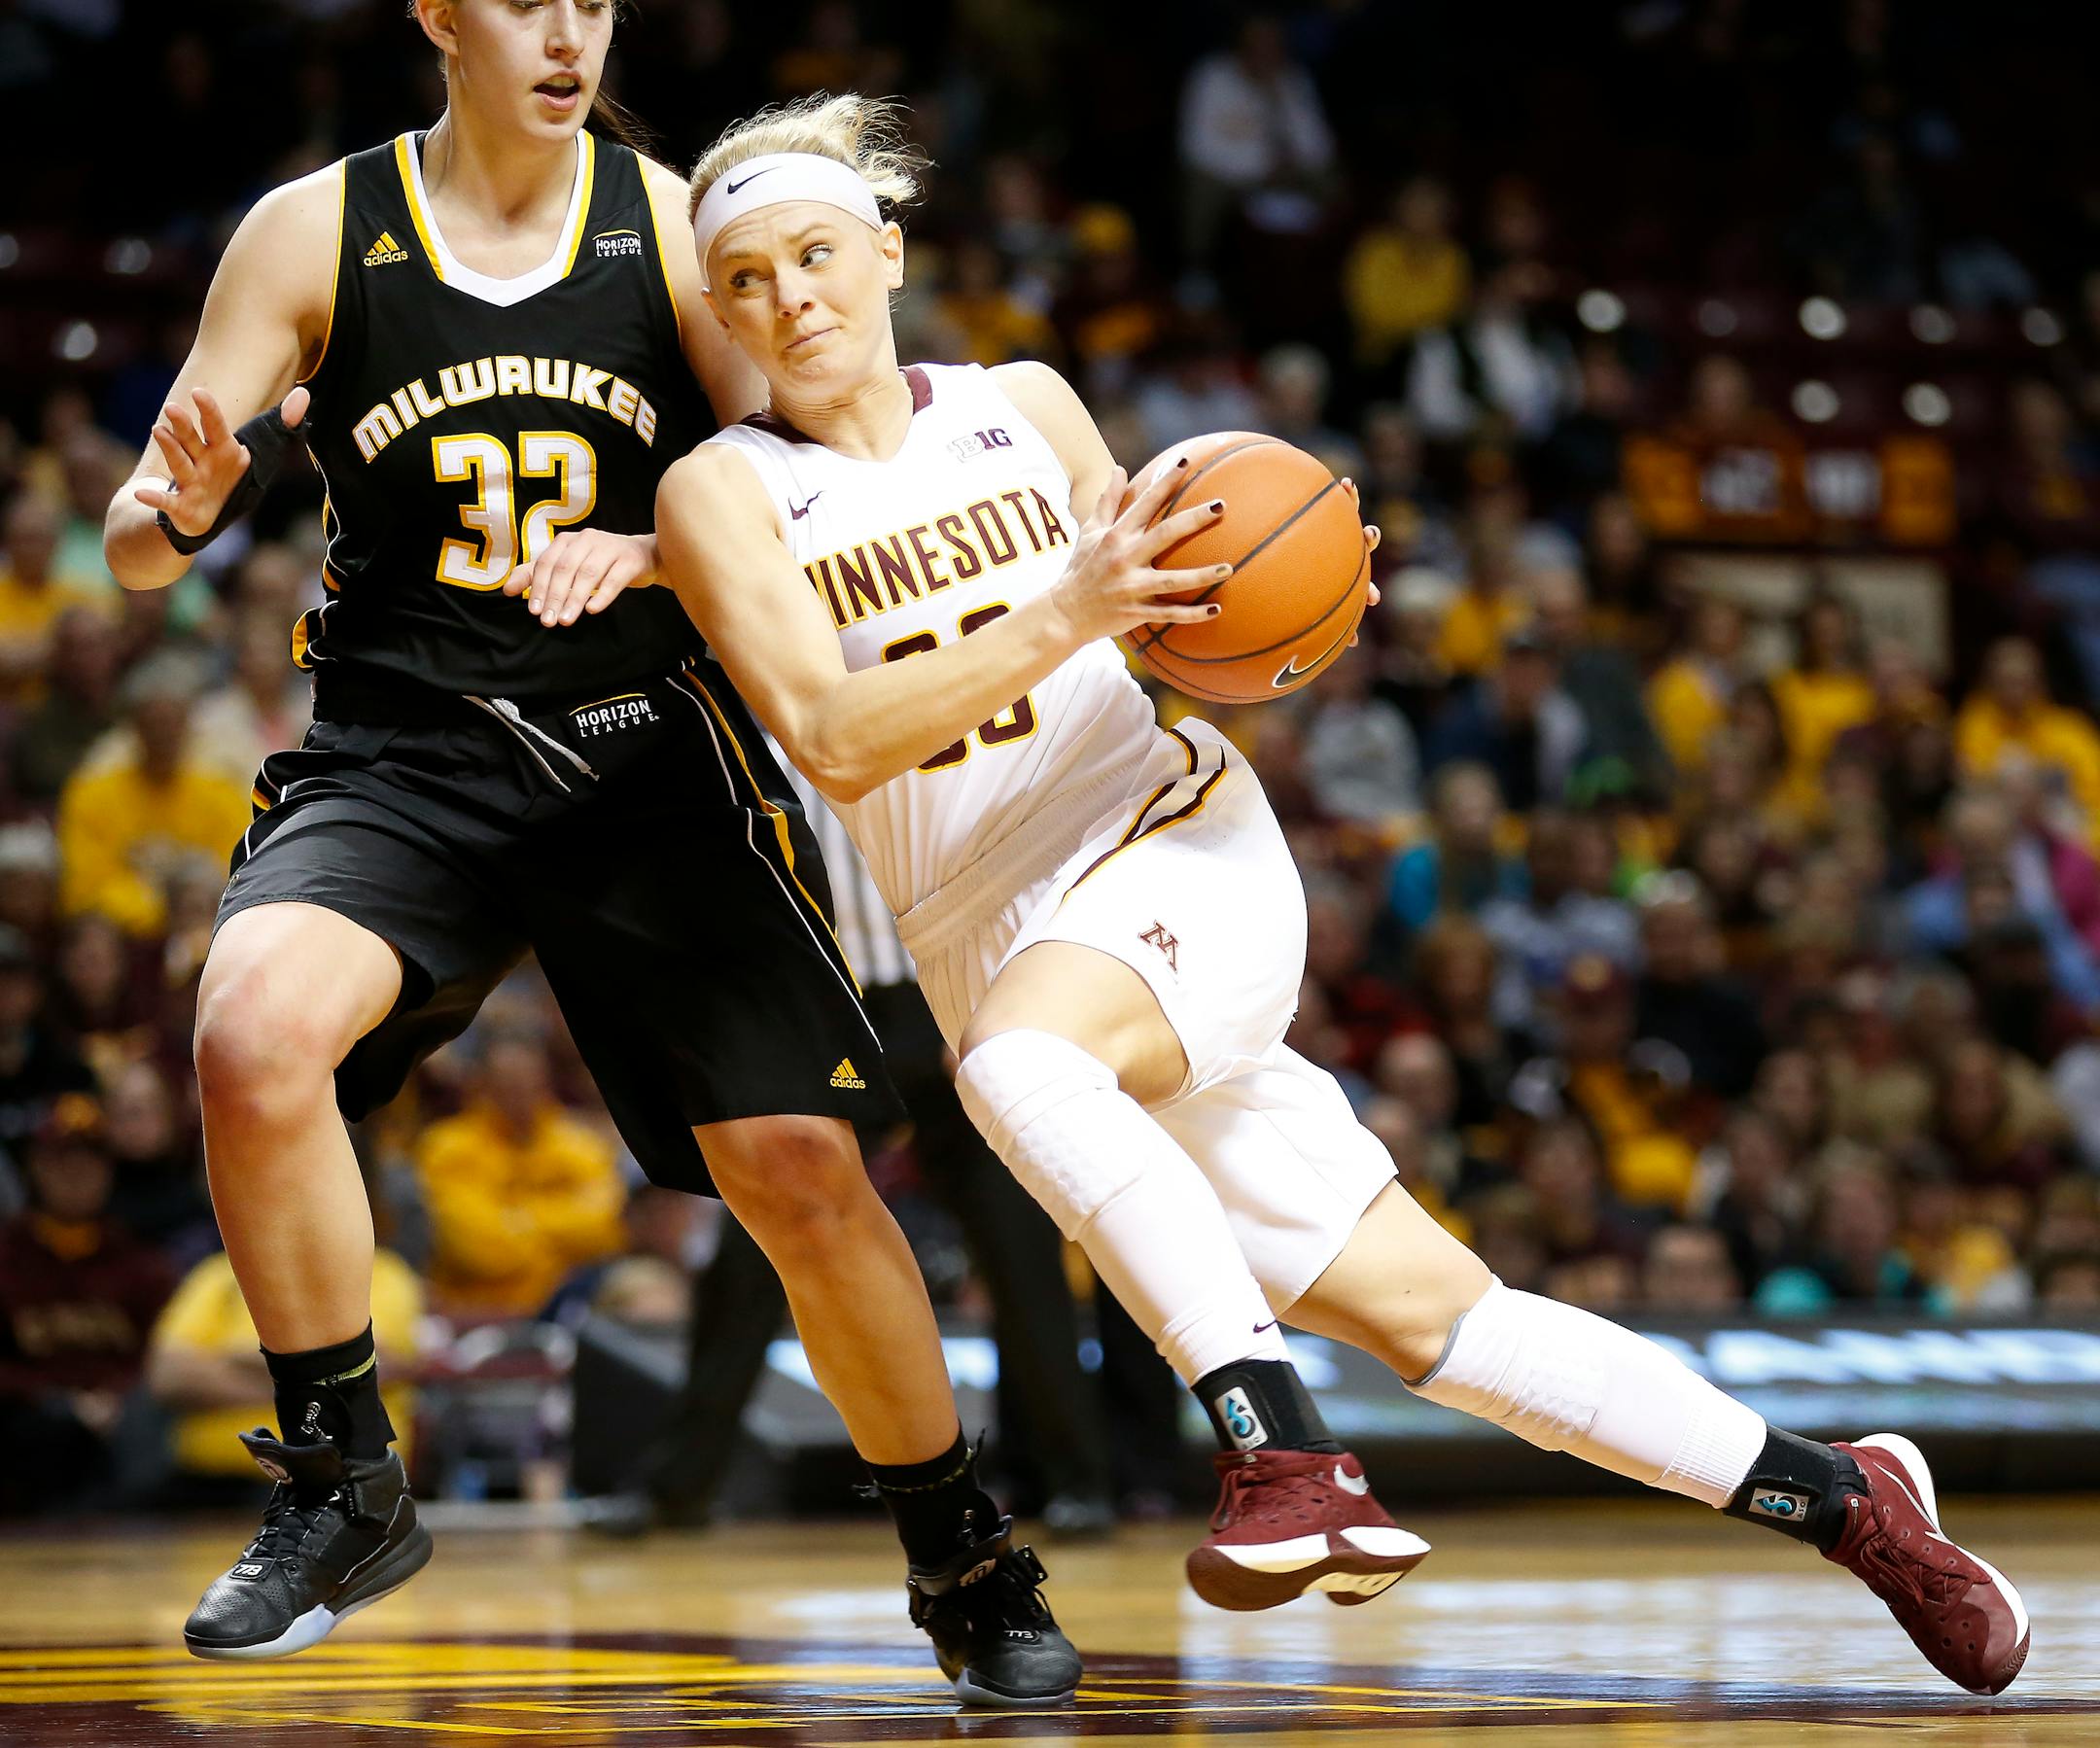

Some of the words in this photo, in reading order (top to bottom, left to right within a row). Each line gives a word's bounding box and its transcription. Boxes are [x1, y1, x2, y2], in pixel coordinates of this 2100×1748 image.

[595, 237, 642, 251] HORIZON
[596, 247, 643, 258] LEAGUE
[364, 251, 408, 266] adidas
[352, 356, 657, 464] MILWAUKEE
[431, 431, 597, 600] 32
[801, 487, 1070, 630] INNESOTA
[576, 700, 651, 728] HORIZON
[580, 714, 655, 737] LEAGUE
[829, 1077, 866, 1089] adidas
